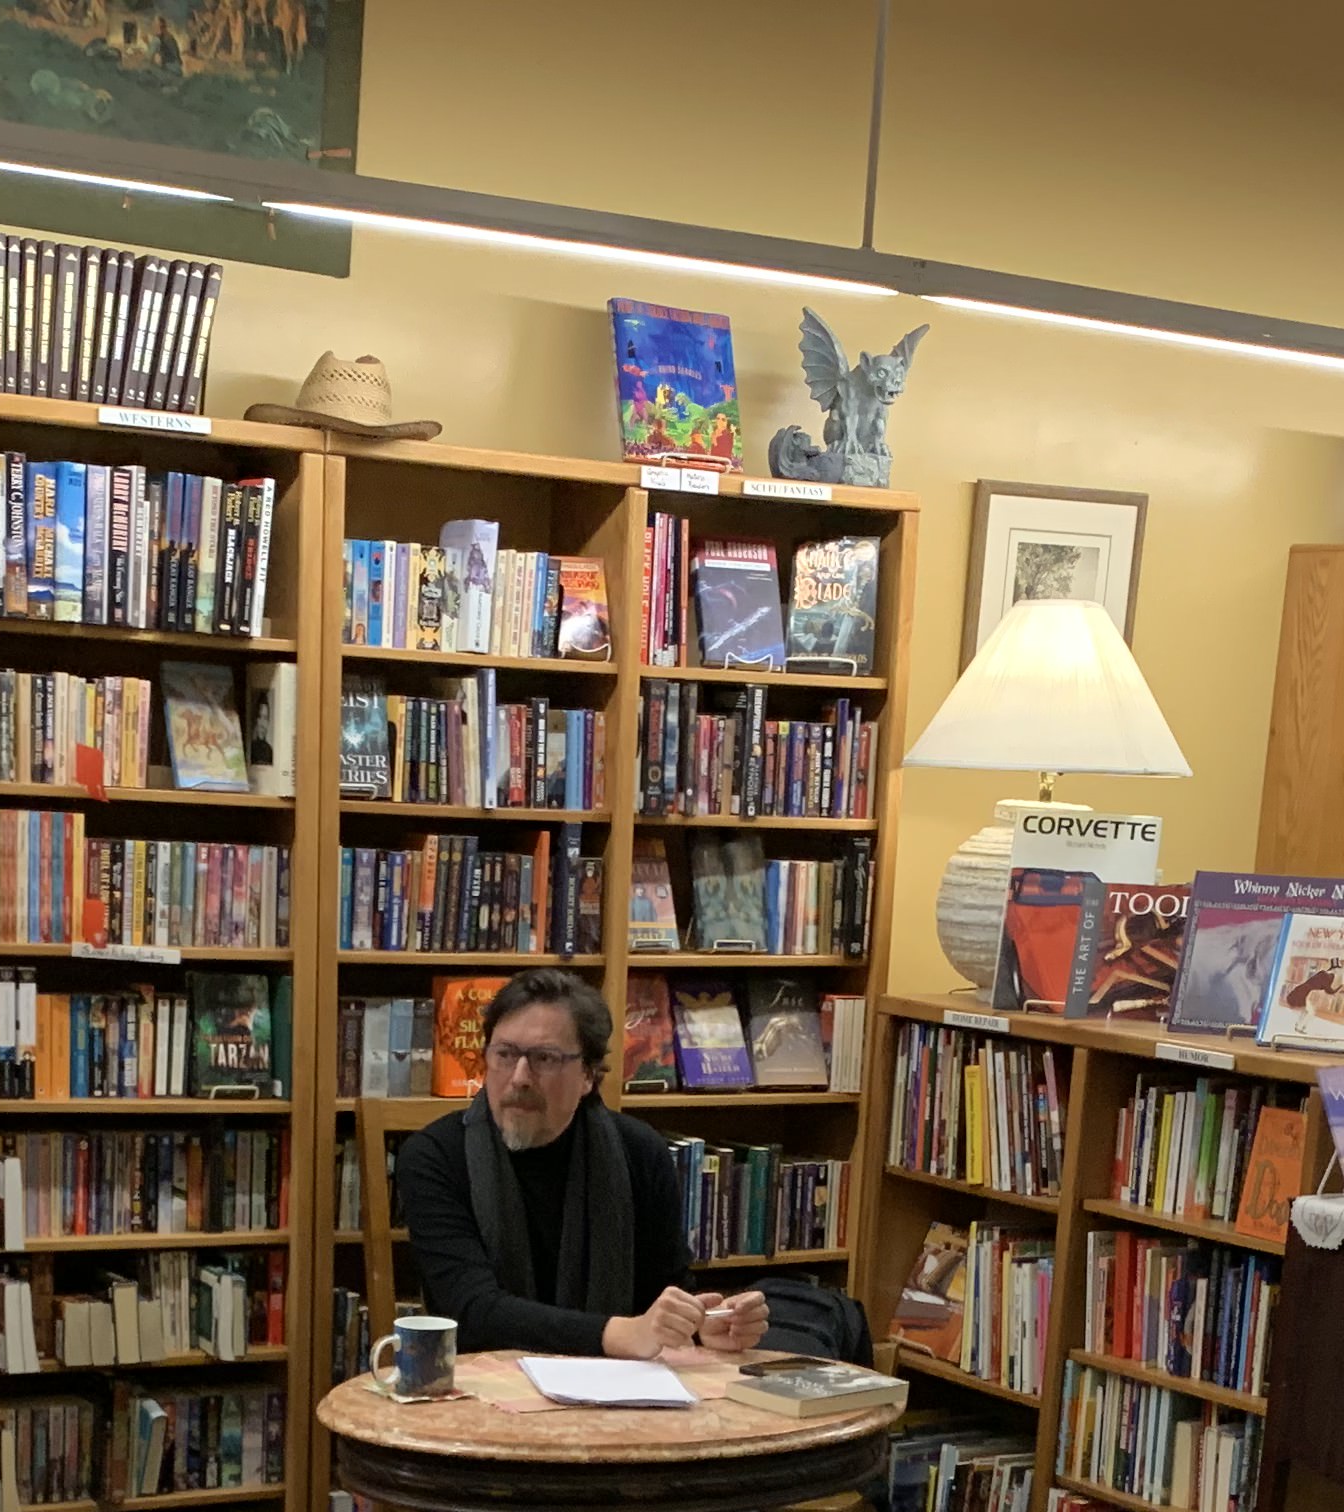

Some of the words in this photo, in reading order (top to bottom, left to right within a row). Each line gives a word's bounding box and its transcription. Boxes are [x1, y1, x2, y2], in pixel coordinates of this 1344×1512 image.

[119, 411, 192, 428] WESTERNS
[113, 472, 129, 501] LARRY
[224, 528, 236, 583] BLACKJACK
[1022, 814, 1158, 843] CORVETTE
[1233, 879, 1281, 898] Whinny
[1285, 882, 1326, 899] Nicker
[1082, 911, 1095, 931] OF
[1077, 935, 1090, 963] ART
[1071, 967, 1086, 994] THE
[209, 1043, 270, 1069] TARZAN
[1178, 1048, 1209, 1063] HUMOR
